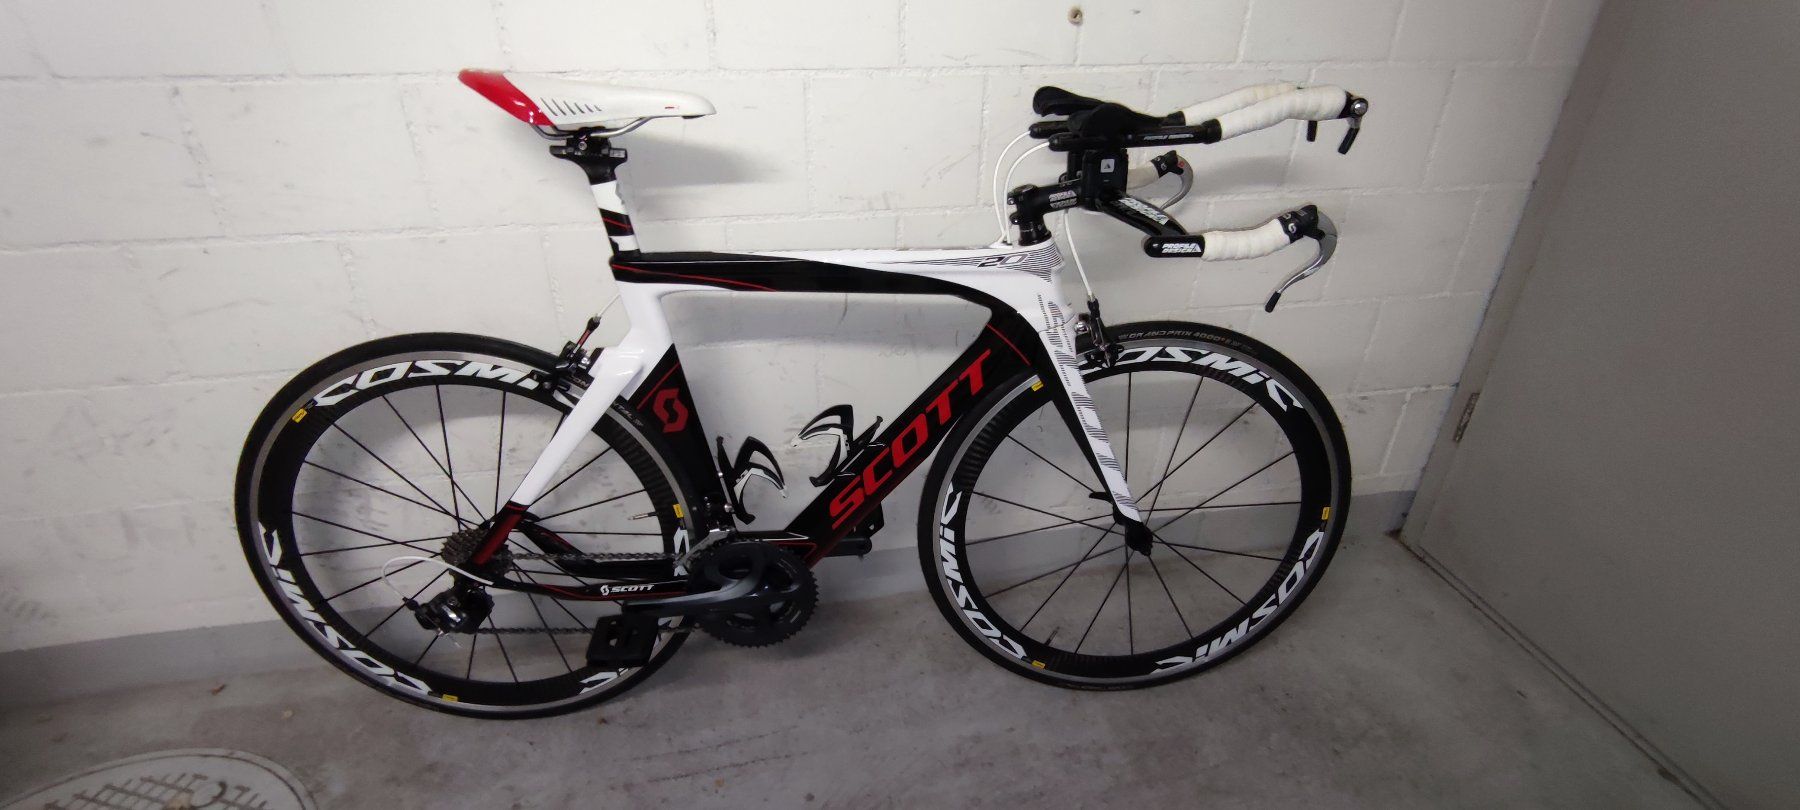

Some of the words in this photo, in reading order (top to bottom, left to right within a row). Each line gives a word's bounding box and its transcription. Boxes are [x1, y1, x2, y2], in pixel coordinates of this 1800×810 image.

[977, 253, 1029, 268] 20
[829, 349, 991, 530] SCOTT
[610, 584, 655, 593] SCOTT
